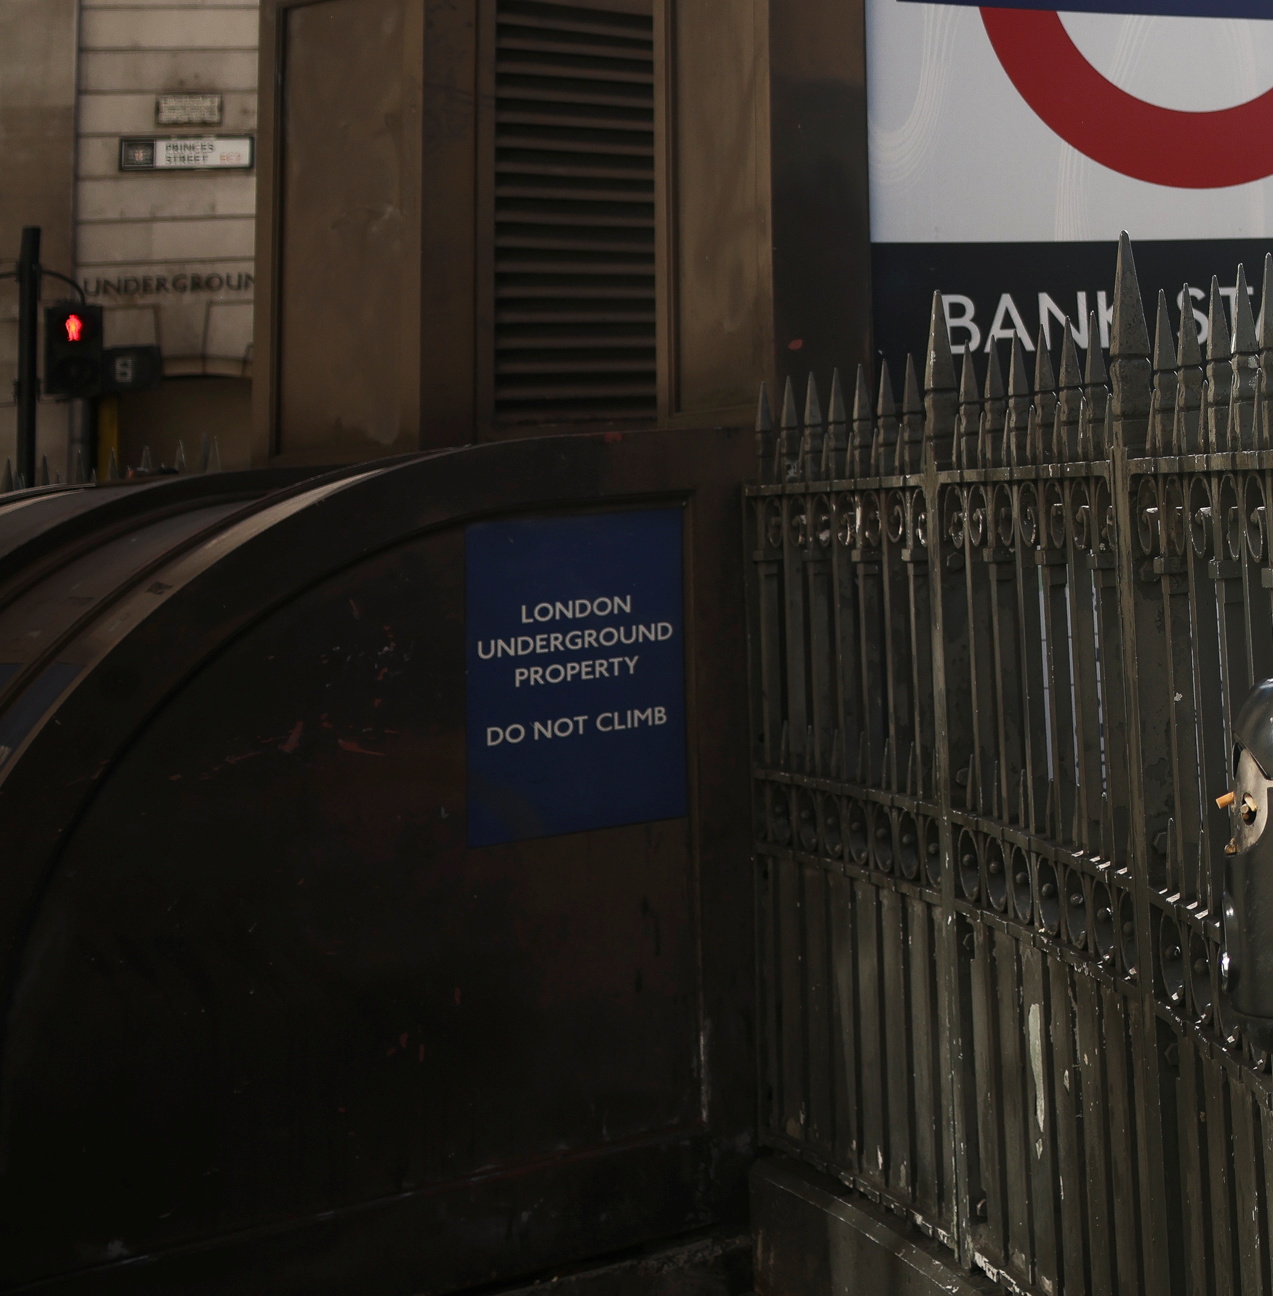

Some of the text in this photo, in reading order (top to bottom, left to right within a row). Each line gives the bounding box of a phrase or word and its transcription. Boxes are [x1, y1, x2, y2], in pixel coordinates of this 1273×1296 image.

[164, 154, 209, 164] STREET
[83, 271, 255, 296] UNDERGROUN
[521, 595, 632, 624] LONDON
[477, 622, 673, 660] UNDERGROUND
[514, 655, 640, 688] PROPERTY
[486, 706, 668, 747] DO NOT CLIMB
